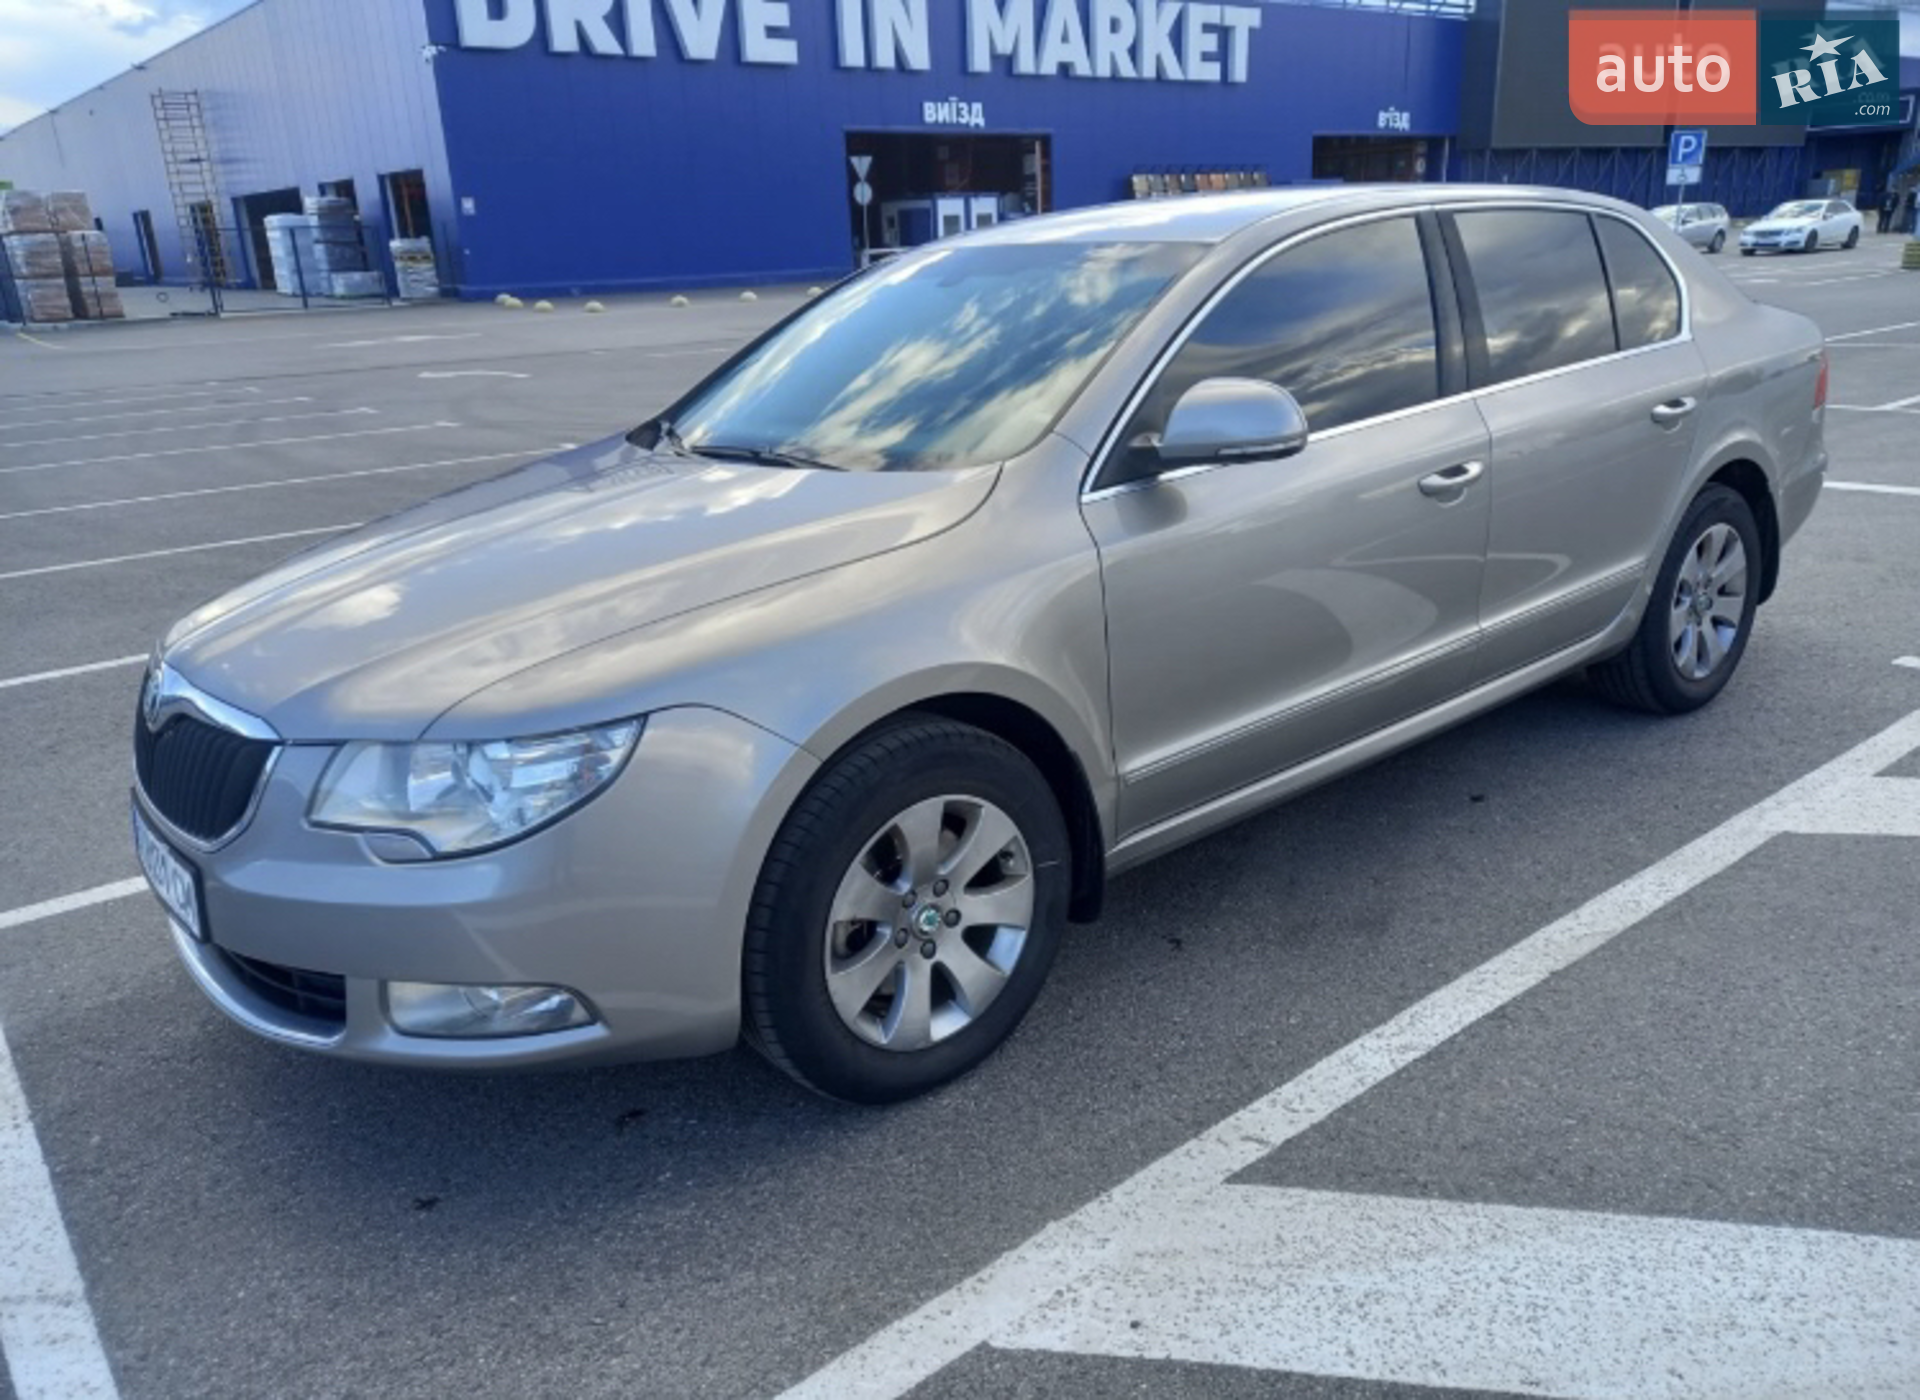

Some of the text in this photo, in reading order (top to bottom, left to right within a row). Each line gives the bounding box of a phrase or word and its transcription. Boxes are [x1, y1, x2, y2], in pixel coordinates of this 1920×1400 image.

[454, 0, 1261, 83] DRIVE IN MARKET
[922, 96, 986, 128] ВИЇЗД
[1678, 135, 1698, 162] P
